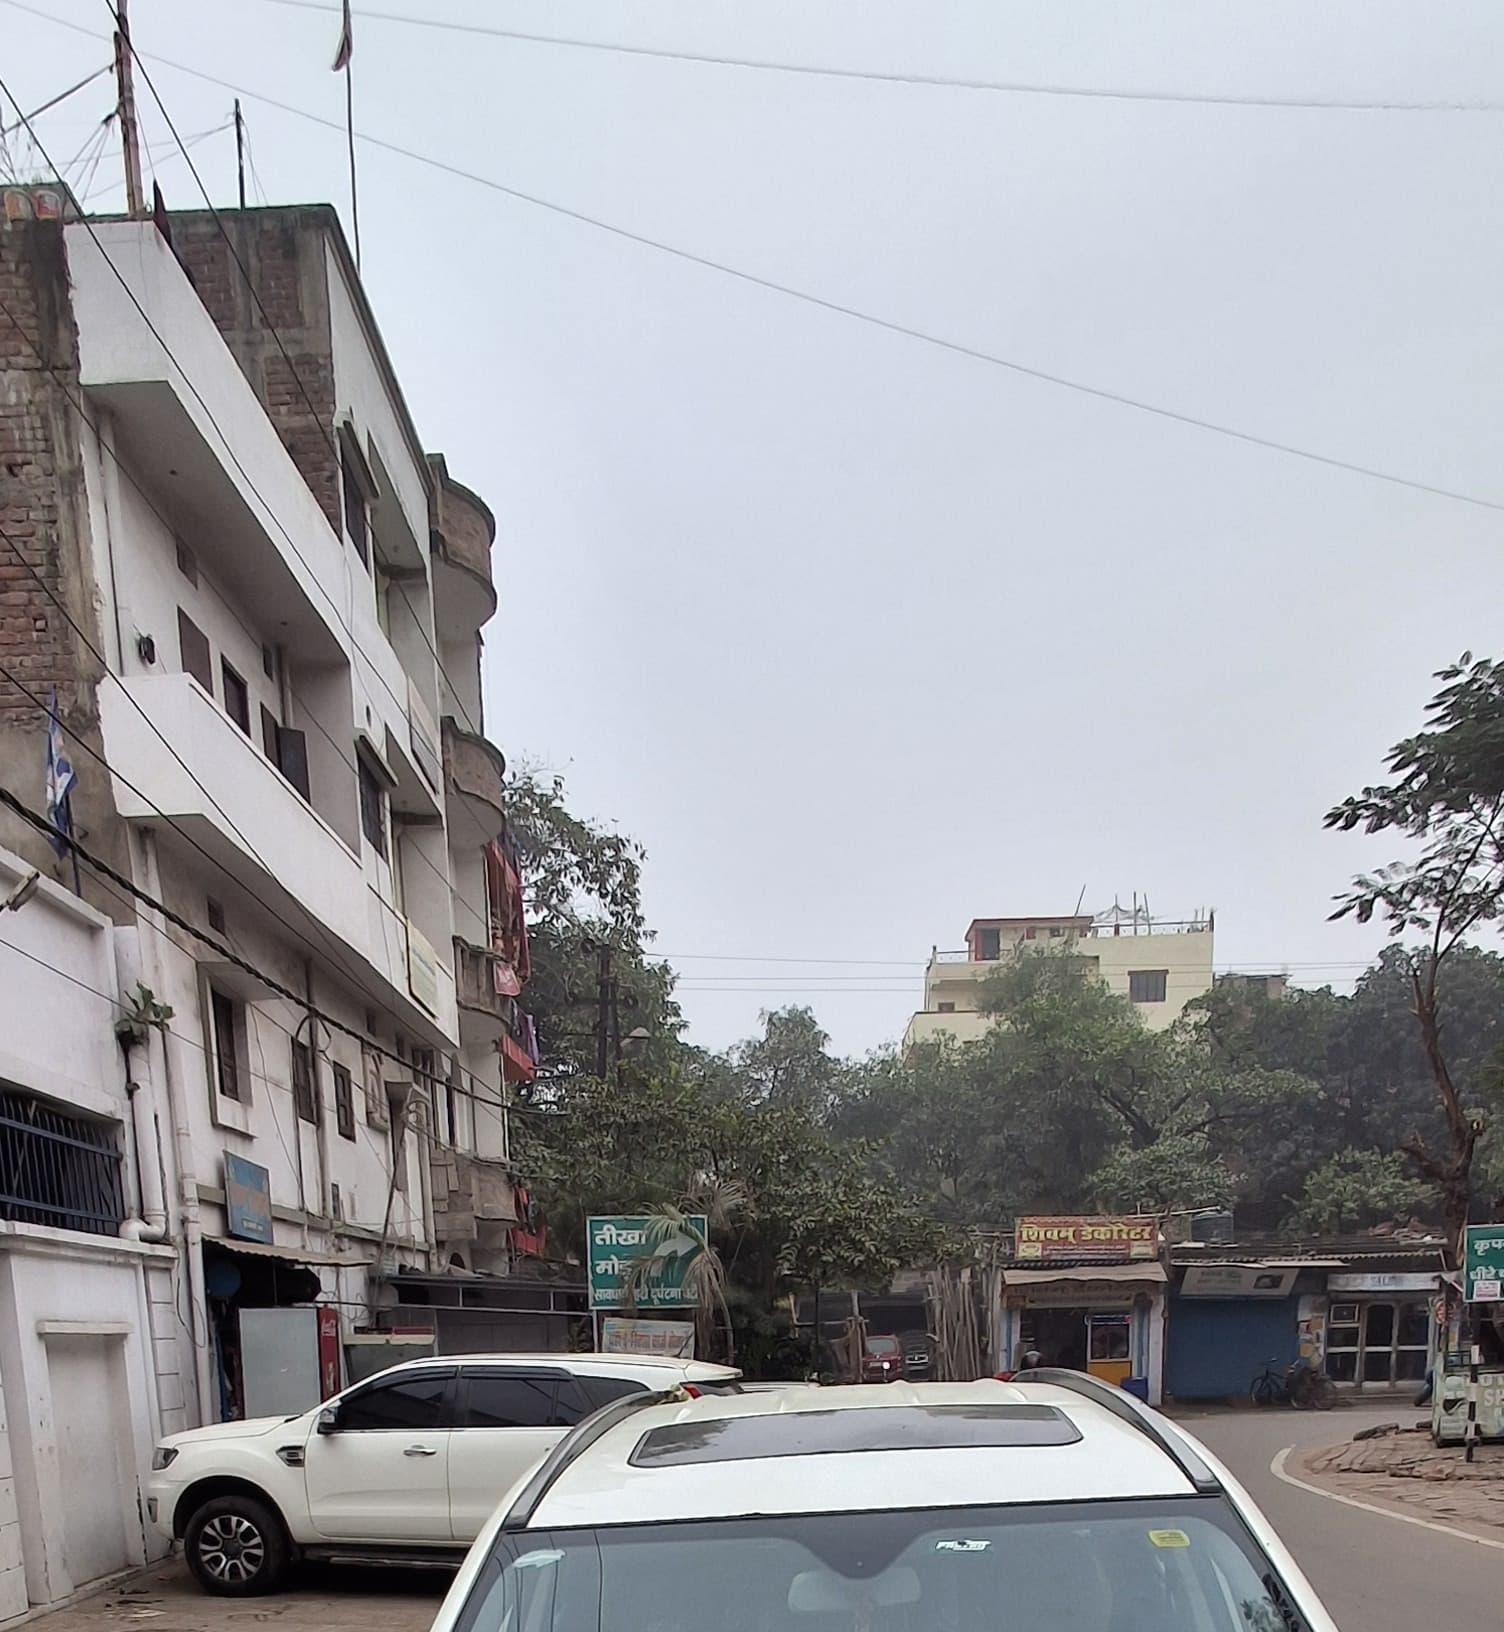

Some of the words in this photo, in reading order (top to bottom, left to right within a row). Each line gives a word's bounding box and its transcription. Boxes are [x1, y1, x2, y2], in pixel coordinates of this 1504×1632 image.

[594, 1223, 647, 1245] तीखा
[1019, 1224, 1077, 1244] शिवम्
[1473, 1238, 1504, 1256] कृप
